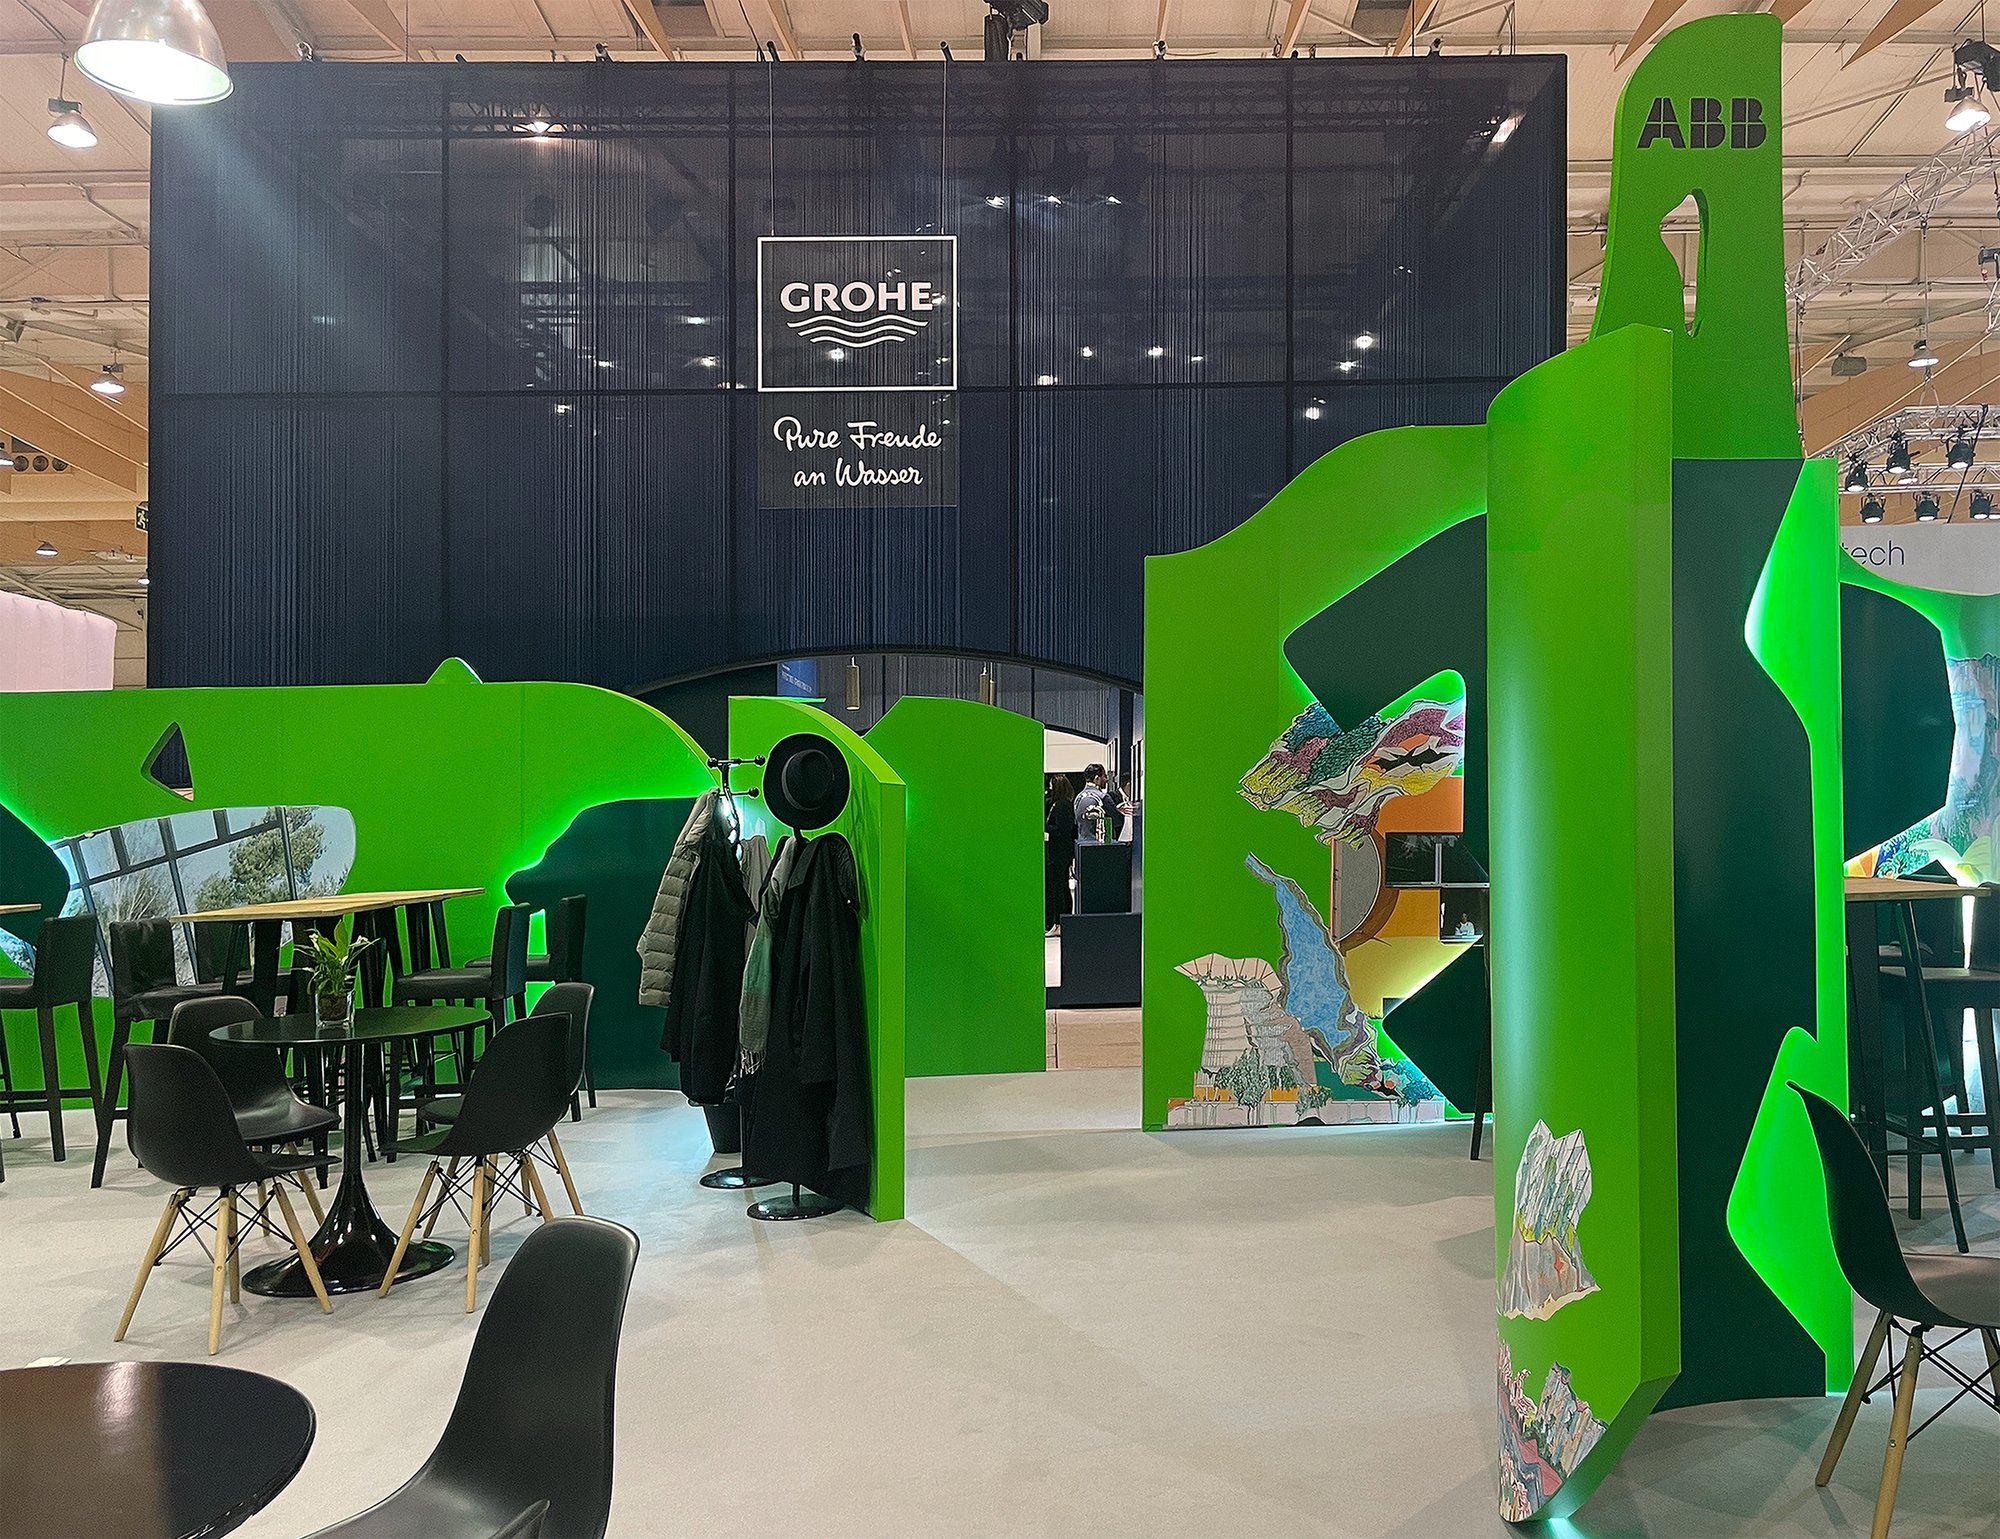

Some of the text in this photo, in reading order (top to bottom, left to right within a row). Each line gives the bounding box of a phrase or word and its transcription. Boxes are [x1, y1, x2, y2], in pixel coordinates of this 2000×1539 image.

[1637, 97, 1767, 149] ABB
[780, 281, 933, 313] GROHE
[773, 416, 942, 451] Pure Freude
[793, 456, 923, 487] an Wasser
